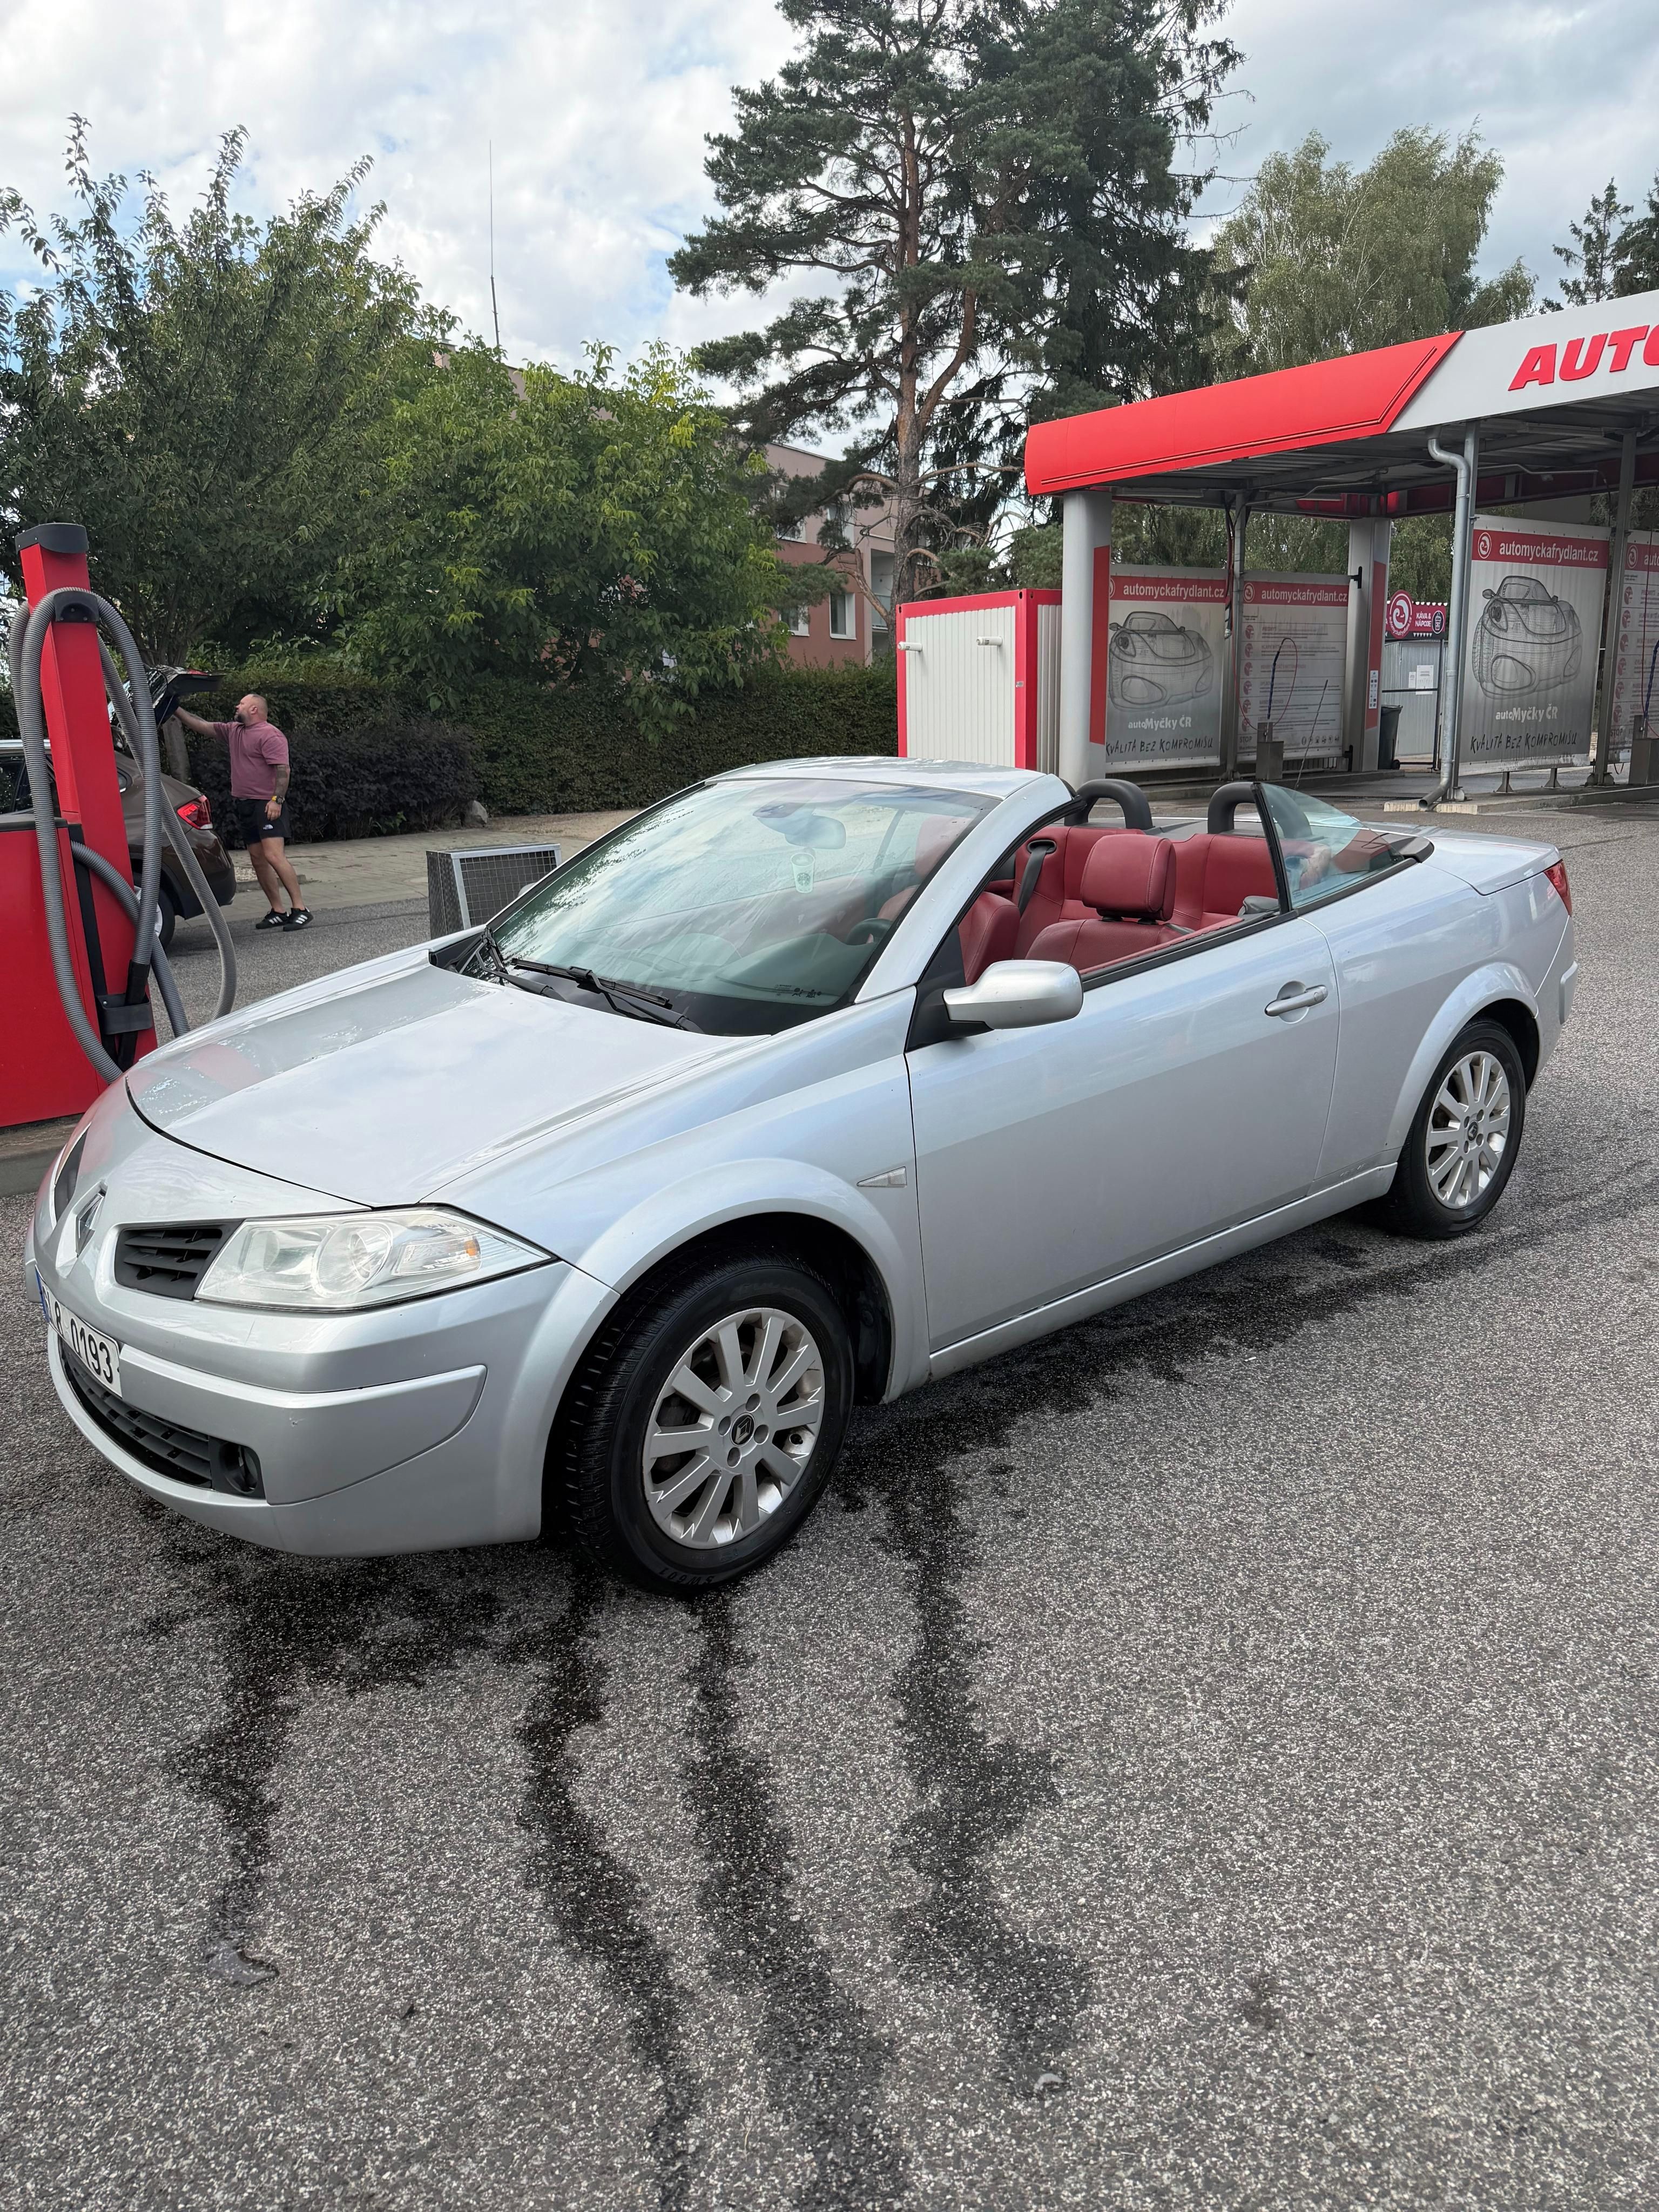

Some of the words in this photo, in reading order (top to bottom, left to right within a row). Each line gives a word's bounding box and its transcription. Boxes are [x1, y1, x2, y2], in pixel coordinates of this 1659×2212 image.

[1499, 541, 1599, 563] automyckafrydlant.cz
[1123, 583, 1224, 599] automyckafrydlant.cz
[1262, 589, 1347, 604] automyckafrydlant.cz
[1495, 706, 1545, 723] autoMyčky
[1546, 703, 1559, 720] ČR
[1128, 717, 1178, 731] autoMyčky
[1179, 714, 1192, 727] ČR
[1105, 739, 1136, 756] KVALITA
[1140, 740, 1156, 752] BEZ
[1471, 733, 1503, 754] KVALITA
[1506, 734, 1522, 750] BEZ
[71, 1318, 113, 1384] 0193
